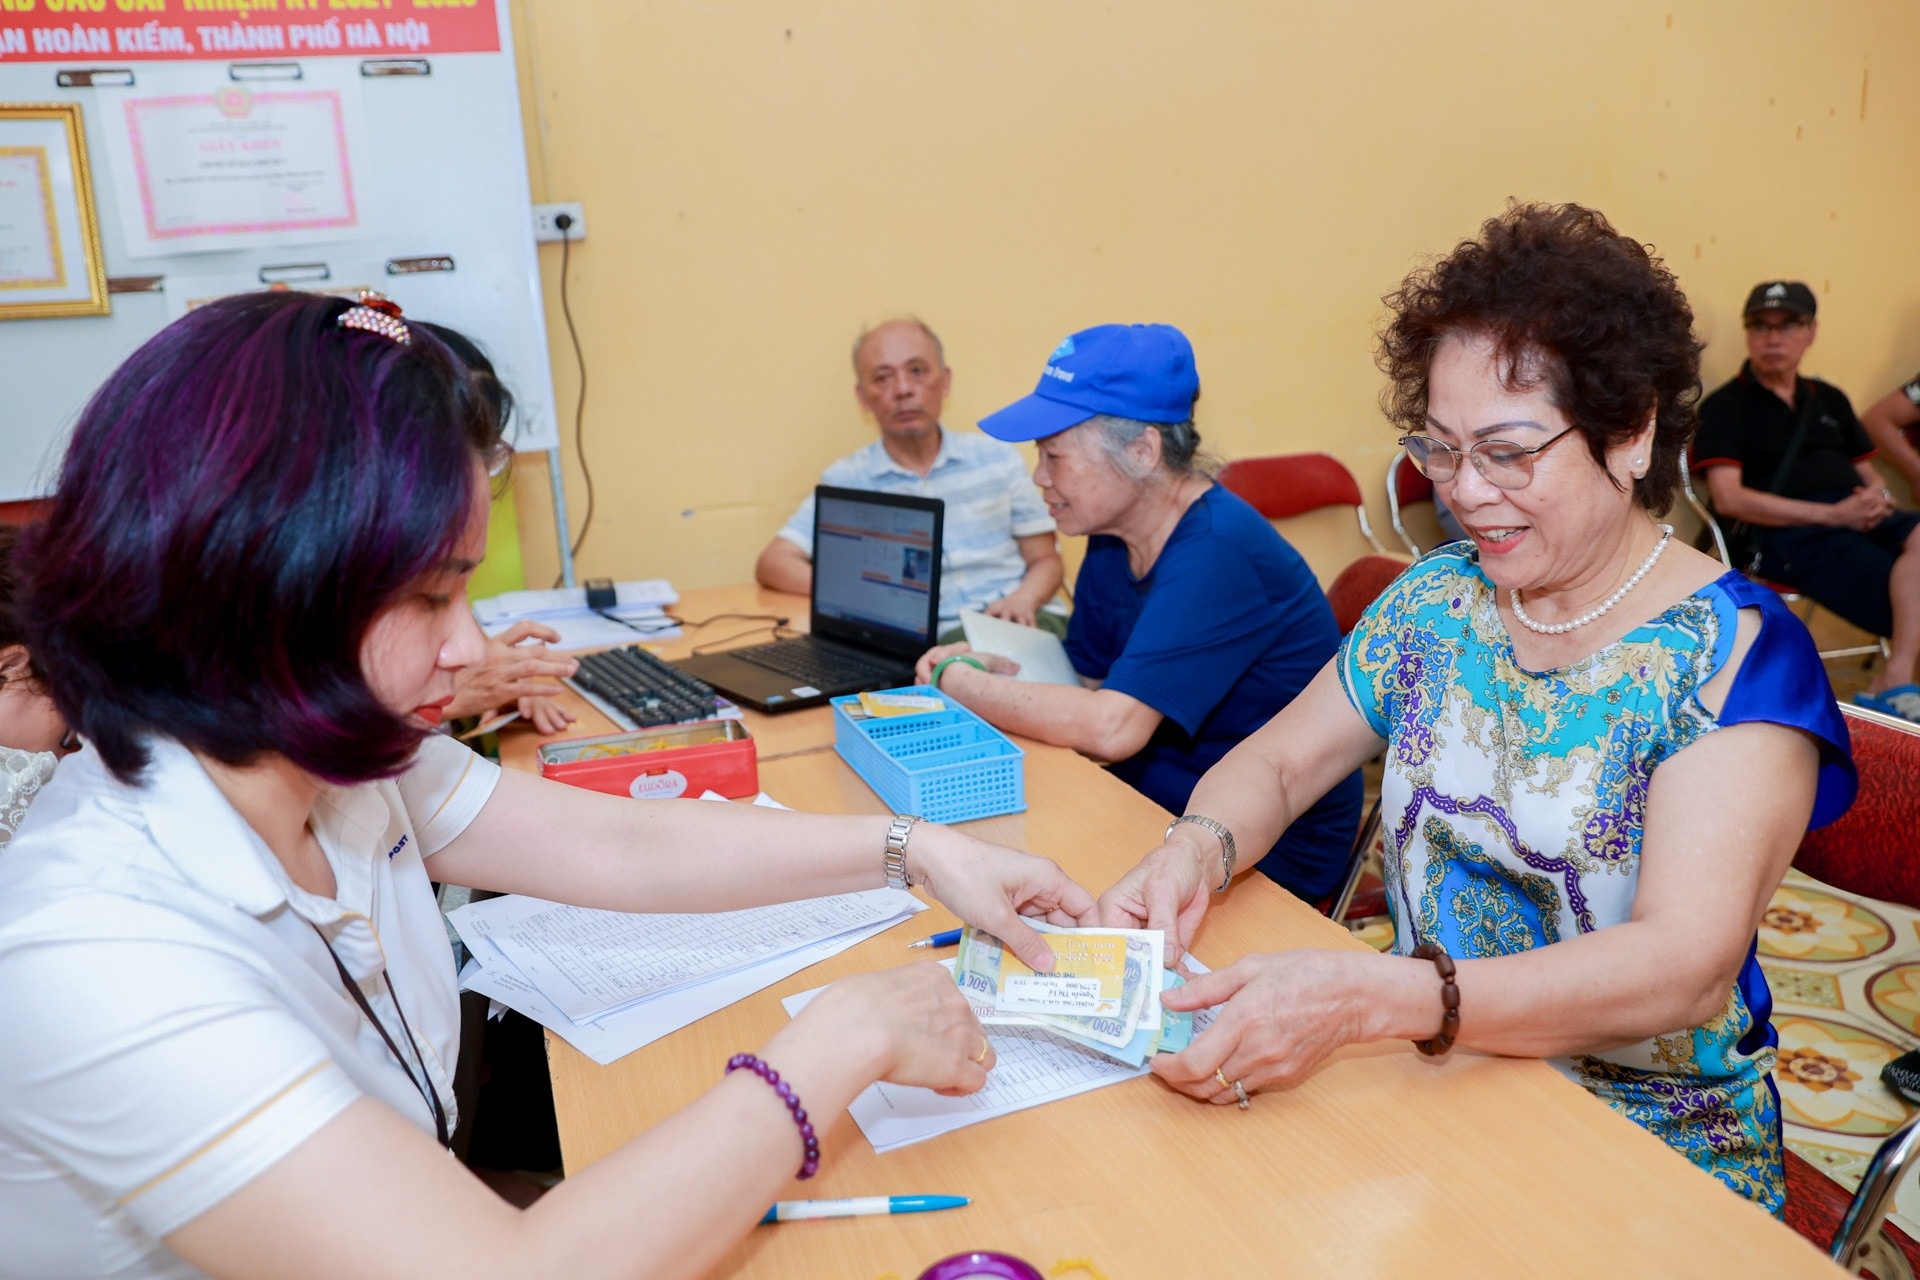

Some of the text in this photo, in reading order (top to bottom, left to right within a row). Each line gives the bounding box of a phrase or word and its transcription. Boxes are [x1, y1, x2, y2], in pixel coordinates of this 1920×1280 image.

[32, 23, 111, 53] HOÀN
[197, 21, 285, 51] THÀNH
[288, 16, 342, 50] PHỐ
[344, 18, 382, 48] HÀ
[384, 17, 430, 51] NỘI
[388, 834, 408, 862] POST
[1092, 1017, 1123, 1038] 5000
